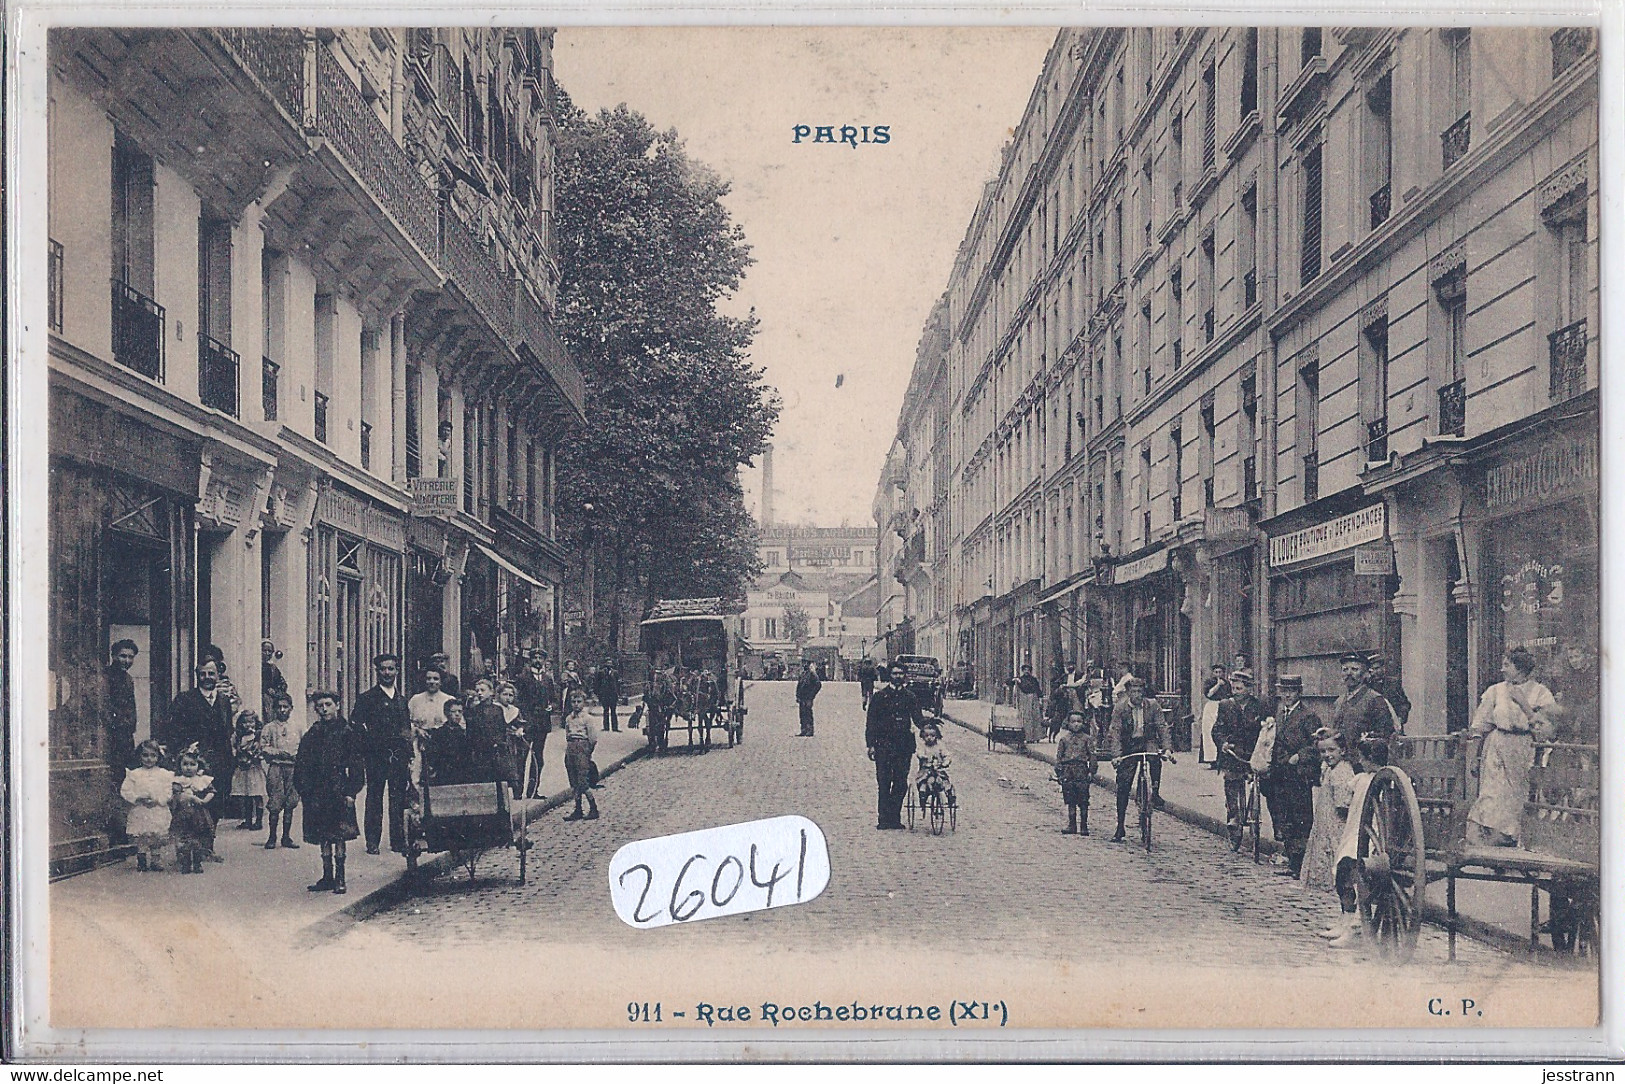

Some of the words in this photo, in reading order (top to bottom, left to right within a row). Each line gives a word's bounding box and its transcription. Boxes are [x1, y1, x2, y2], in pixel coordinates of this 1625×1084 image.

[792, 124, 891, 149] PARIS
[412, 479, 455, 491] VITRERIE
[1277, 535, 1298, 561] LOUER
[619, 828, 808, 923] 26041
[626, 1001, 664, 1023] 911
[696, 1001, 752, 1026] Rue
[760, 1000, 942, 1026] Rochebrune
[1428, 998, 1450, 1016] C.
[1462, 998, 1483, 1016] P.
